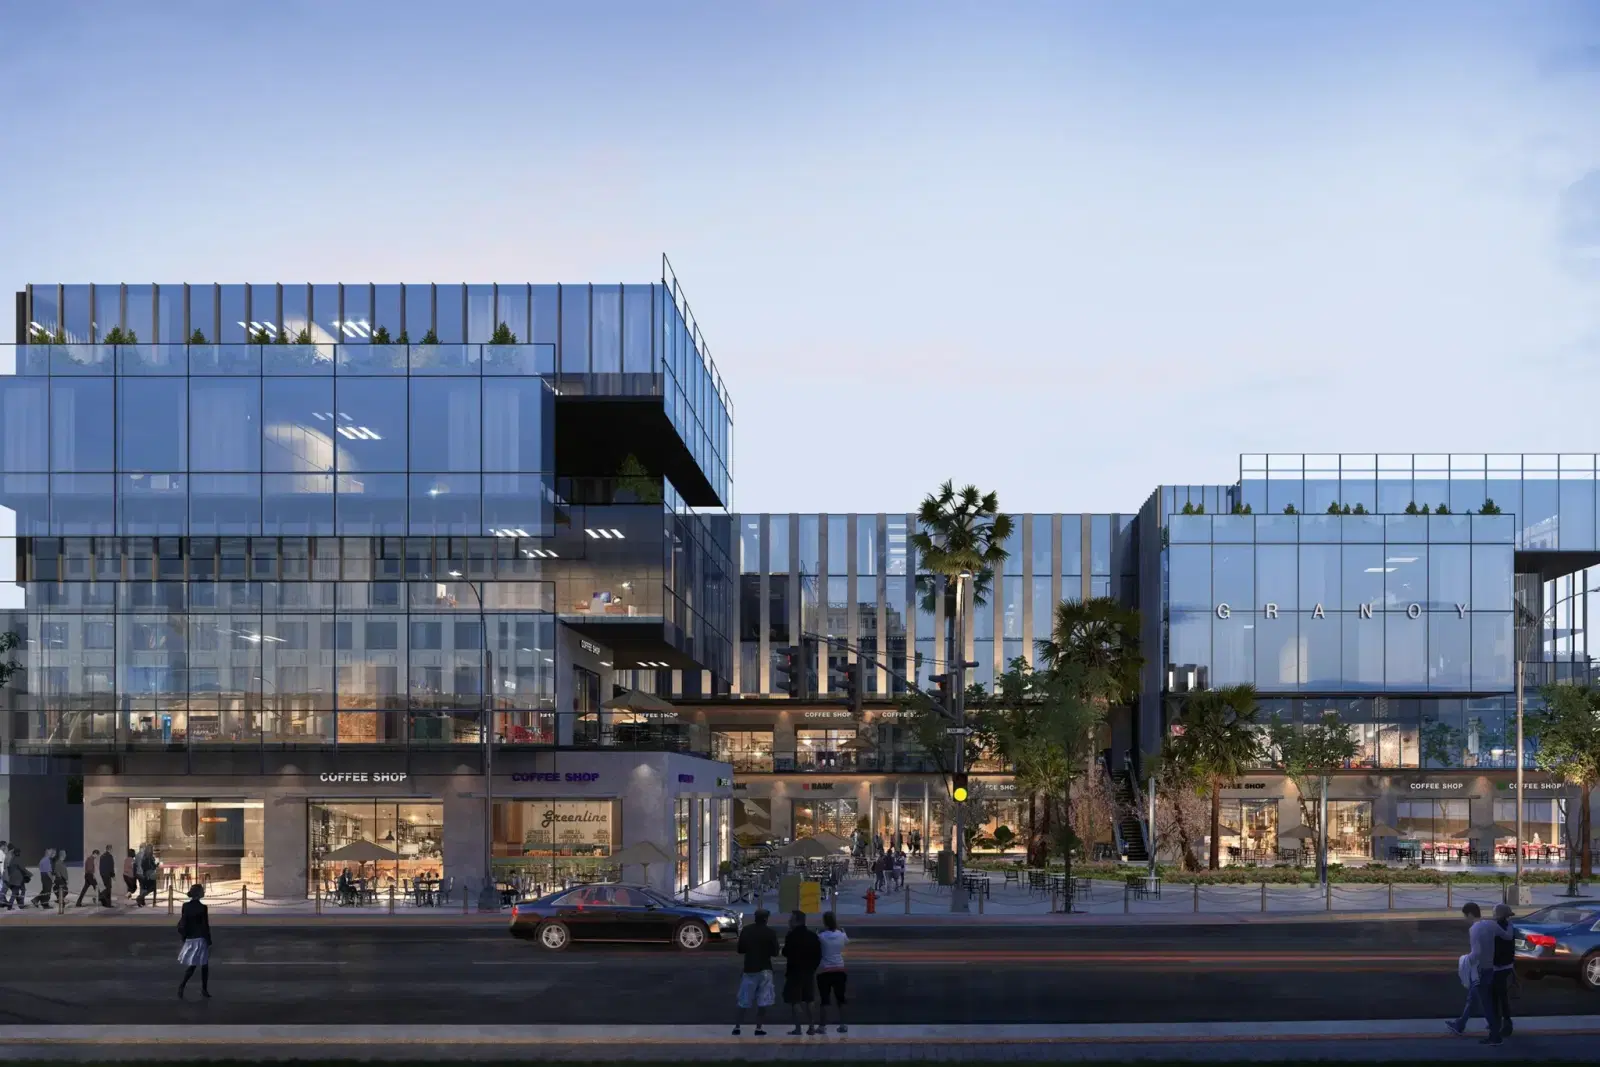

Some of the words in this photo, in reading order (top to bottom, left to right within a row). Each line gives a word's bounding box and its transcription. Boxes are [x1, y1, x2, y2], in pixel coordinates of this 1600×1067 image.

[1217, 603, 1468, 620] GRANOY
[319, 772, 368, 782] COFFEE
[373, 772, 407, 782] SHOP
[512, 772, 561, 782] COFFEE
[565, 772, 600, 782] SHOP
[541, 810, 607, 828] Greenline
